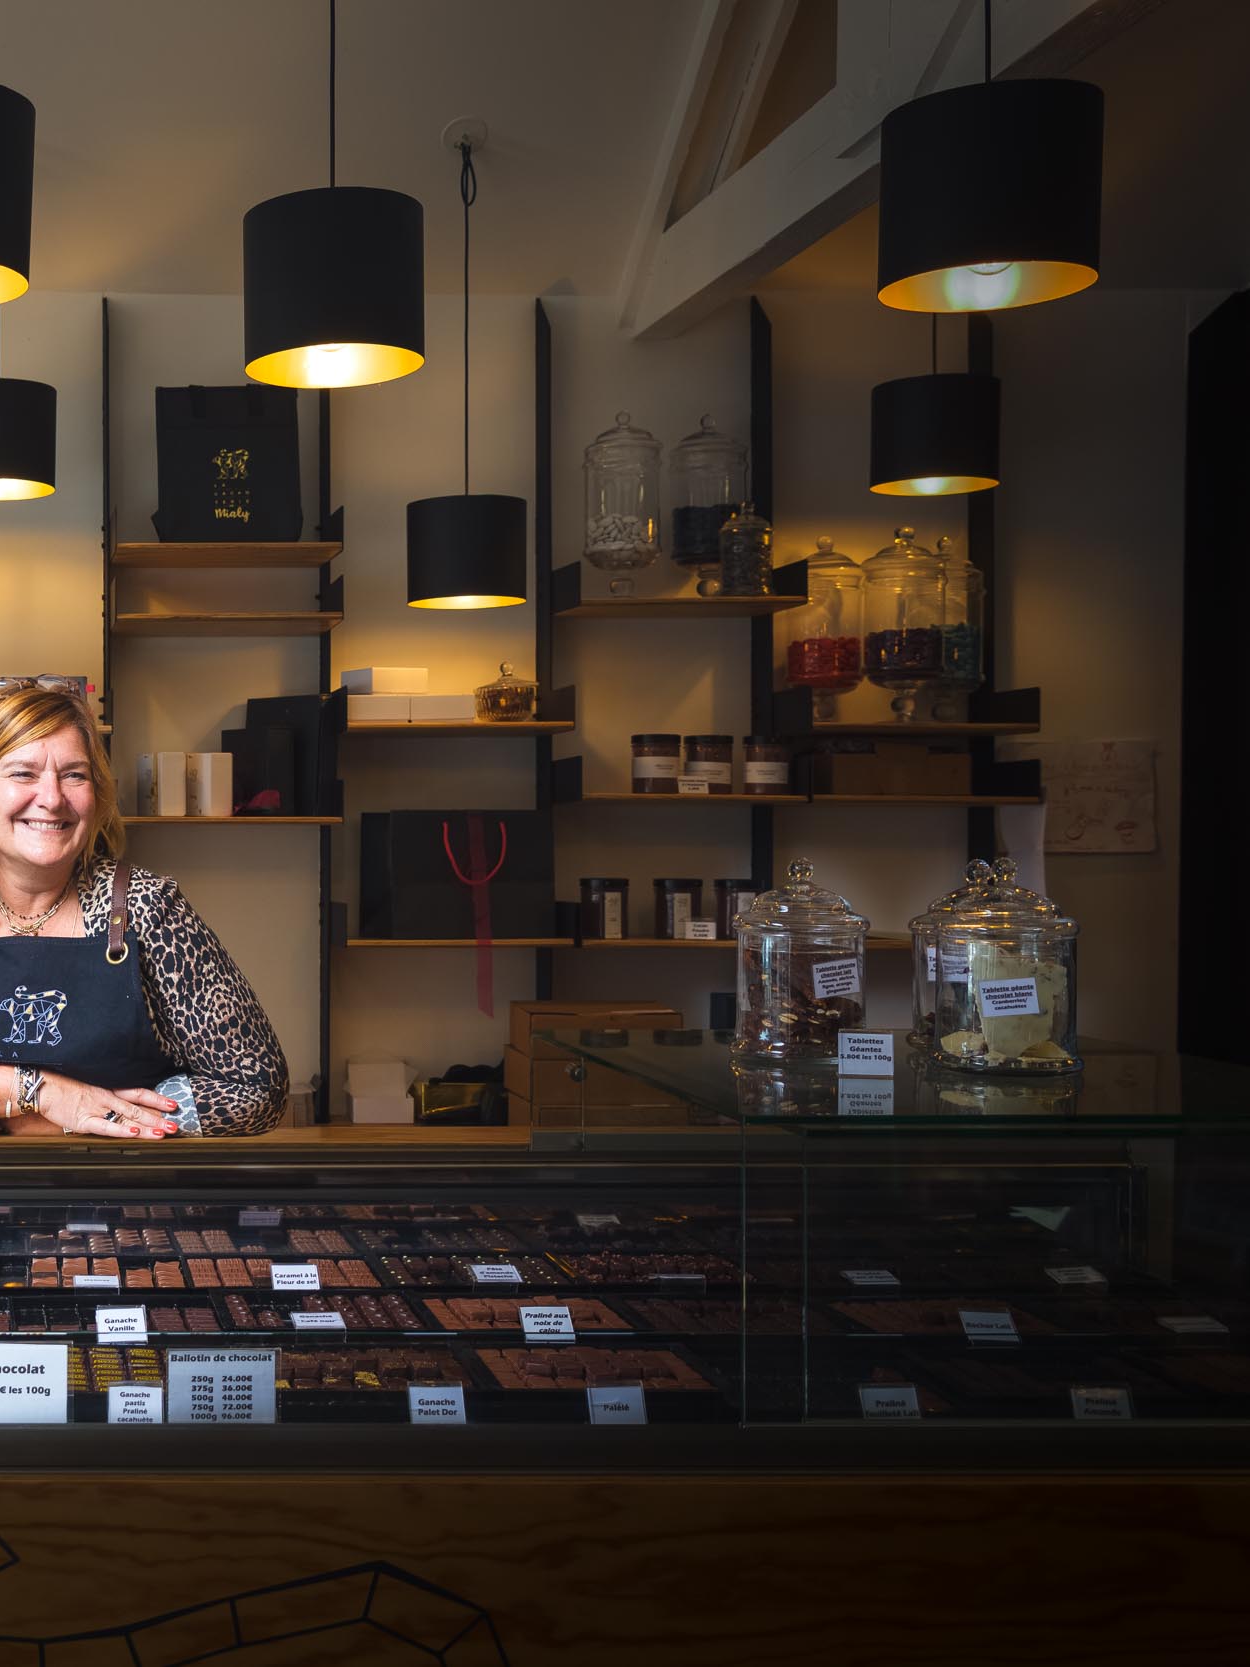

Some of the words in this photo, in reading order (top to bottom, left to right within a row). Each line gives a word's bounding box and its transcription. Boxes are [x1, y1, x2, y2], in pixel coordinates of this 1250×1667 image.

[214, 506, 251, 523] Mialy
[1011, 984, 1035, 992] géante
[985, 993, 1013, 1001] chocolat
[1014, 991, 1033, 999] blanc
[847, 1037, 884, 1045] Tablettes
[849, 1045, 882, 1053] Géantes
[874, 1054, 892, 1062] 100g
[170, 1353, 211, 1362] Ballotin
[213, 1353, 227, 1362] de
[228, 1353, 273, 1362] chocolat
[191, 1375, 214, 1384] 250g
[8, 1386, 23, 1394] les
[26, 1386, 51, 1397] 100g
[191, 1384, 214, 1393] 375g
[191, 1394, 214, 1402] 500g
[417, 1398, 456, 1406] Ganache
[122, 1407, 148, 1415] Praliné
[192, 1403, 215, 1412] 750g
[417, 1408, 440, 1416] Palet
[190, 1413, 218, 1421] 1000g
